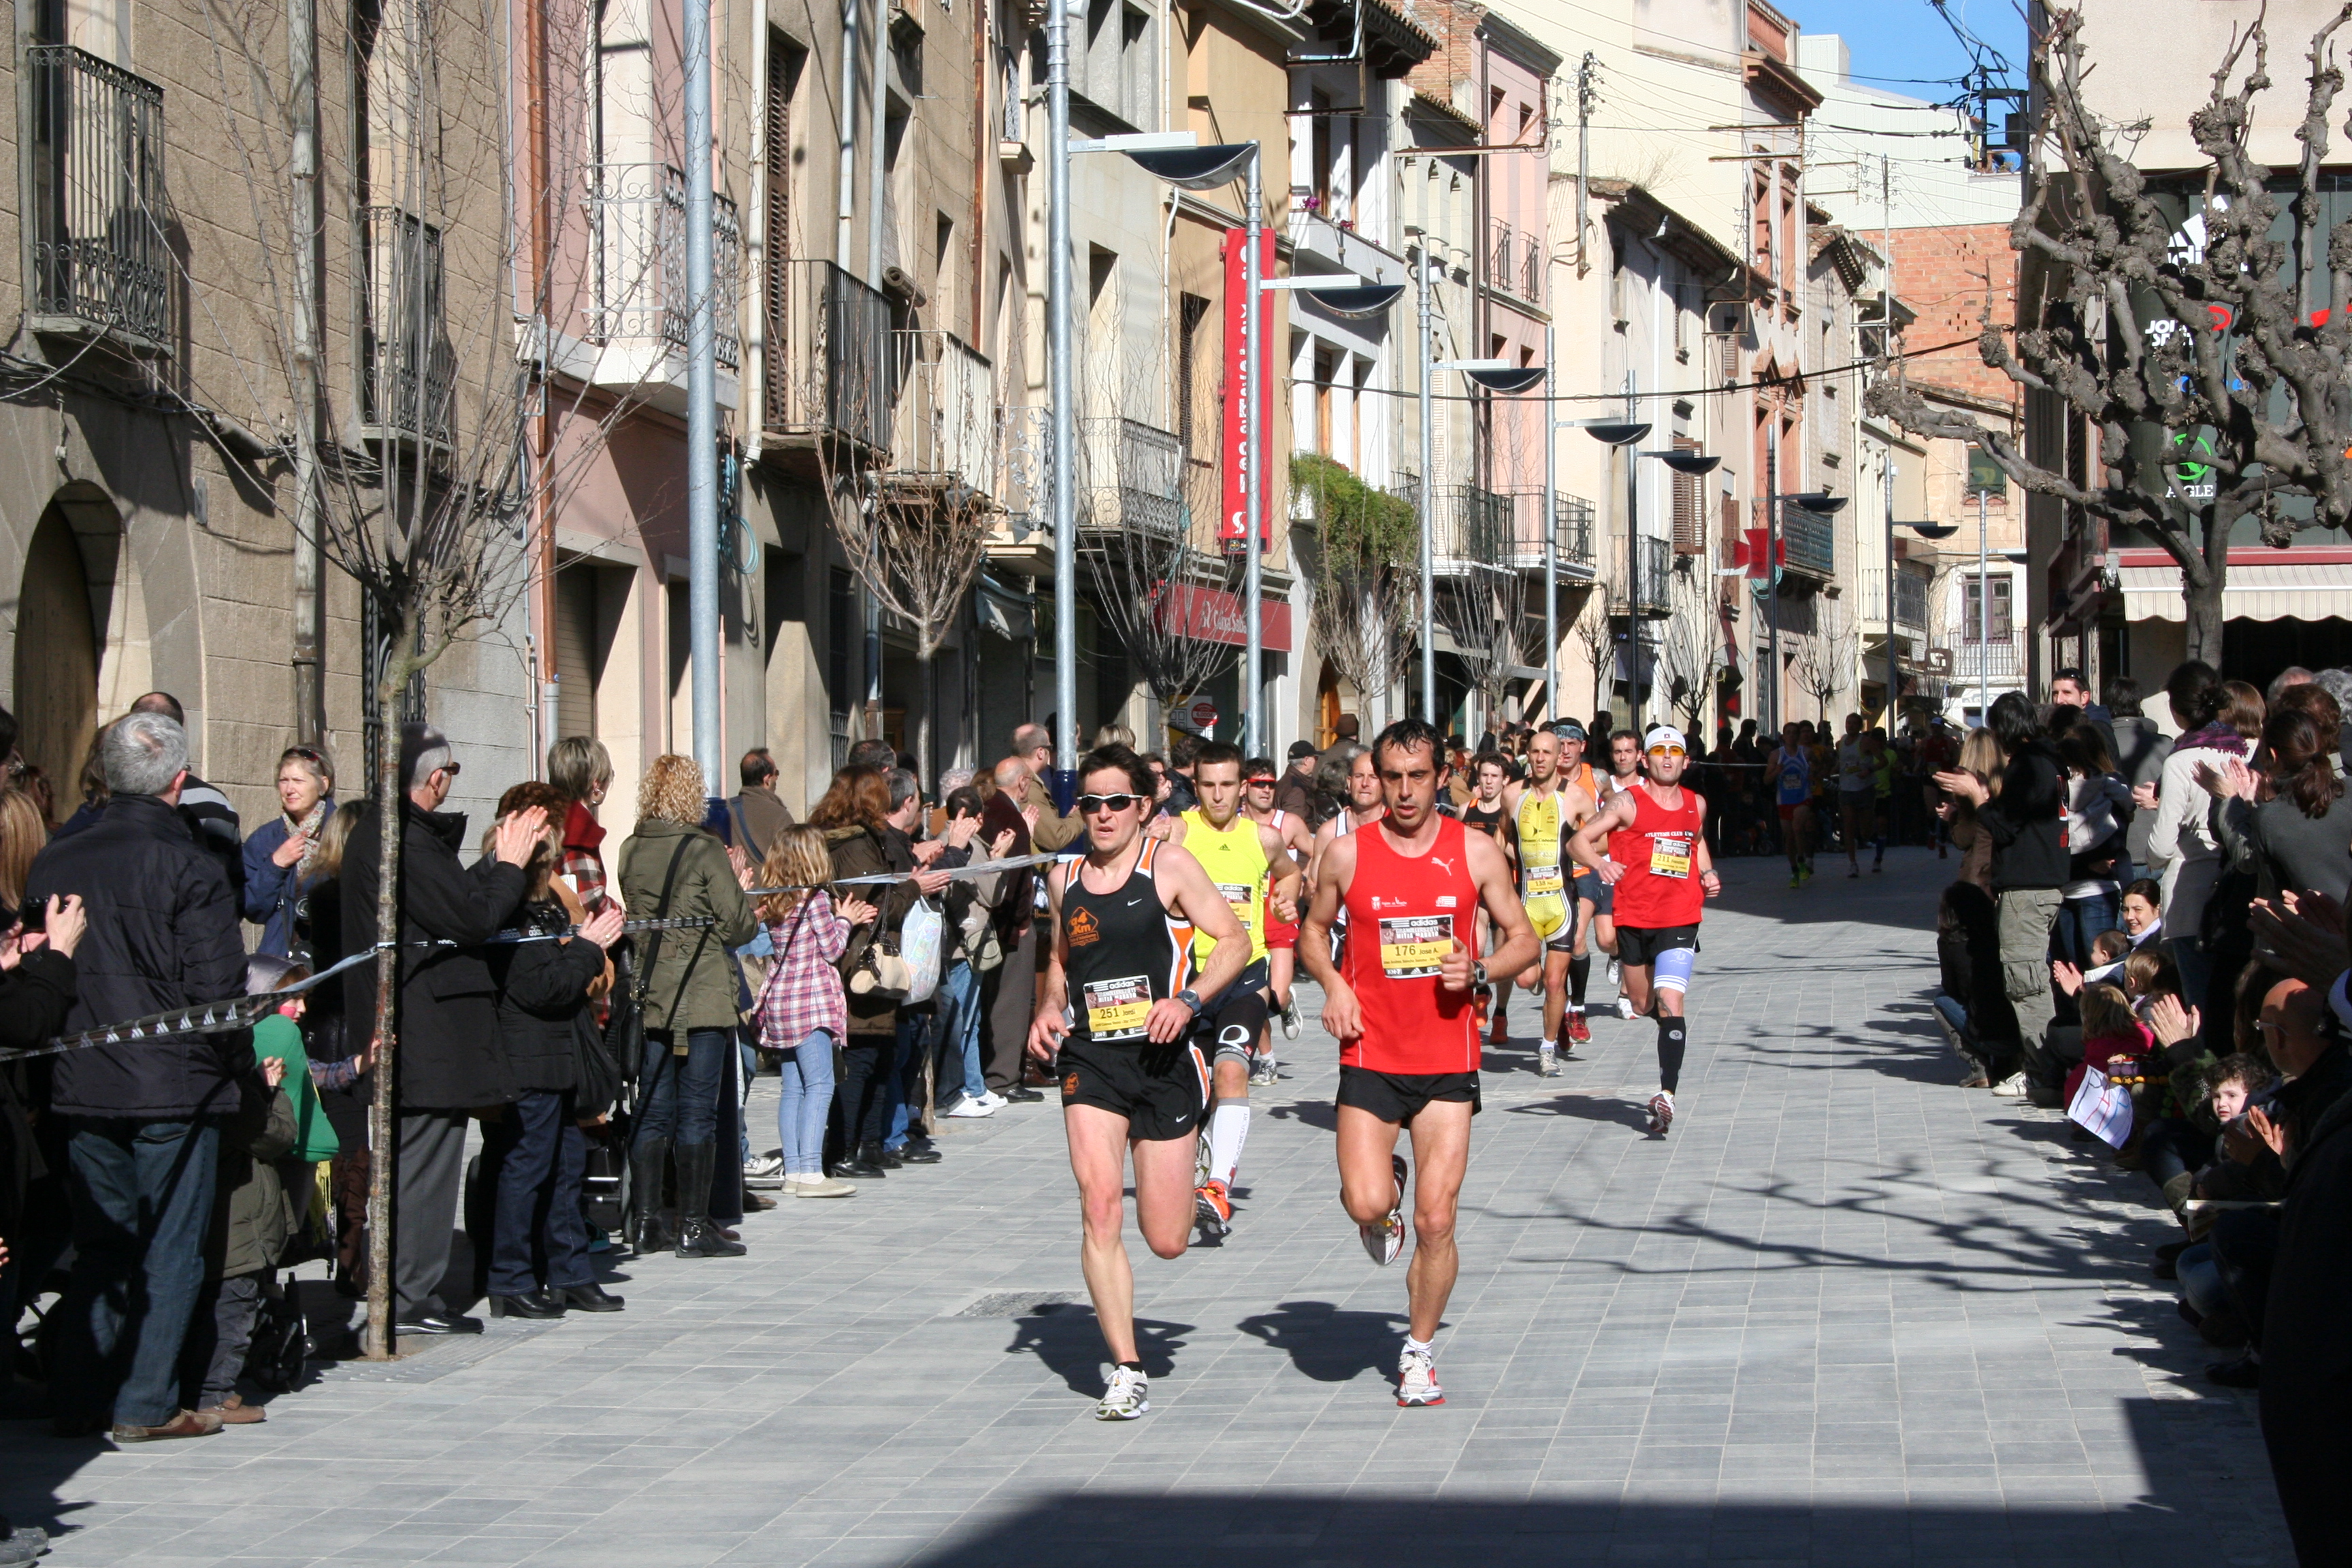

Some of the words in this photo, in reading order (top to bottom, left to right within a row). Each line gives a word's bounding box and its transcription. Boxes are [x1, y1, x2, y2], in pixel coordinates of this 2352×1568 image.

[2144, 319, 2188, 335] JO
[2165, 485, 2215, 498] AGLE
[1657, 855, 1670, 863] 211
[1395, 945, 1416, 956] 176
[1109, 980, 1135, 990] adidas
[1100, 1007, 1120, 1019] 251
